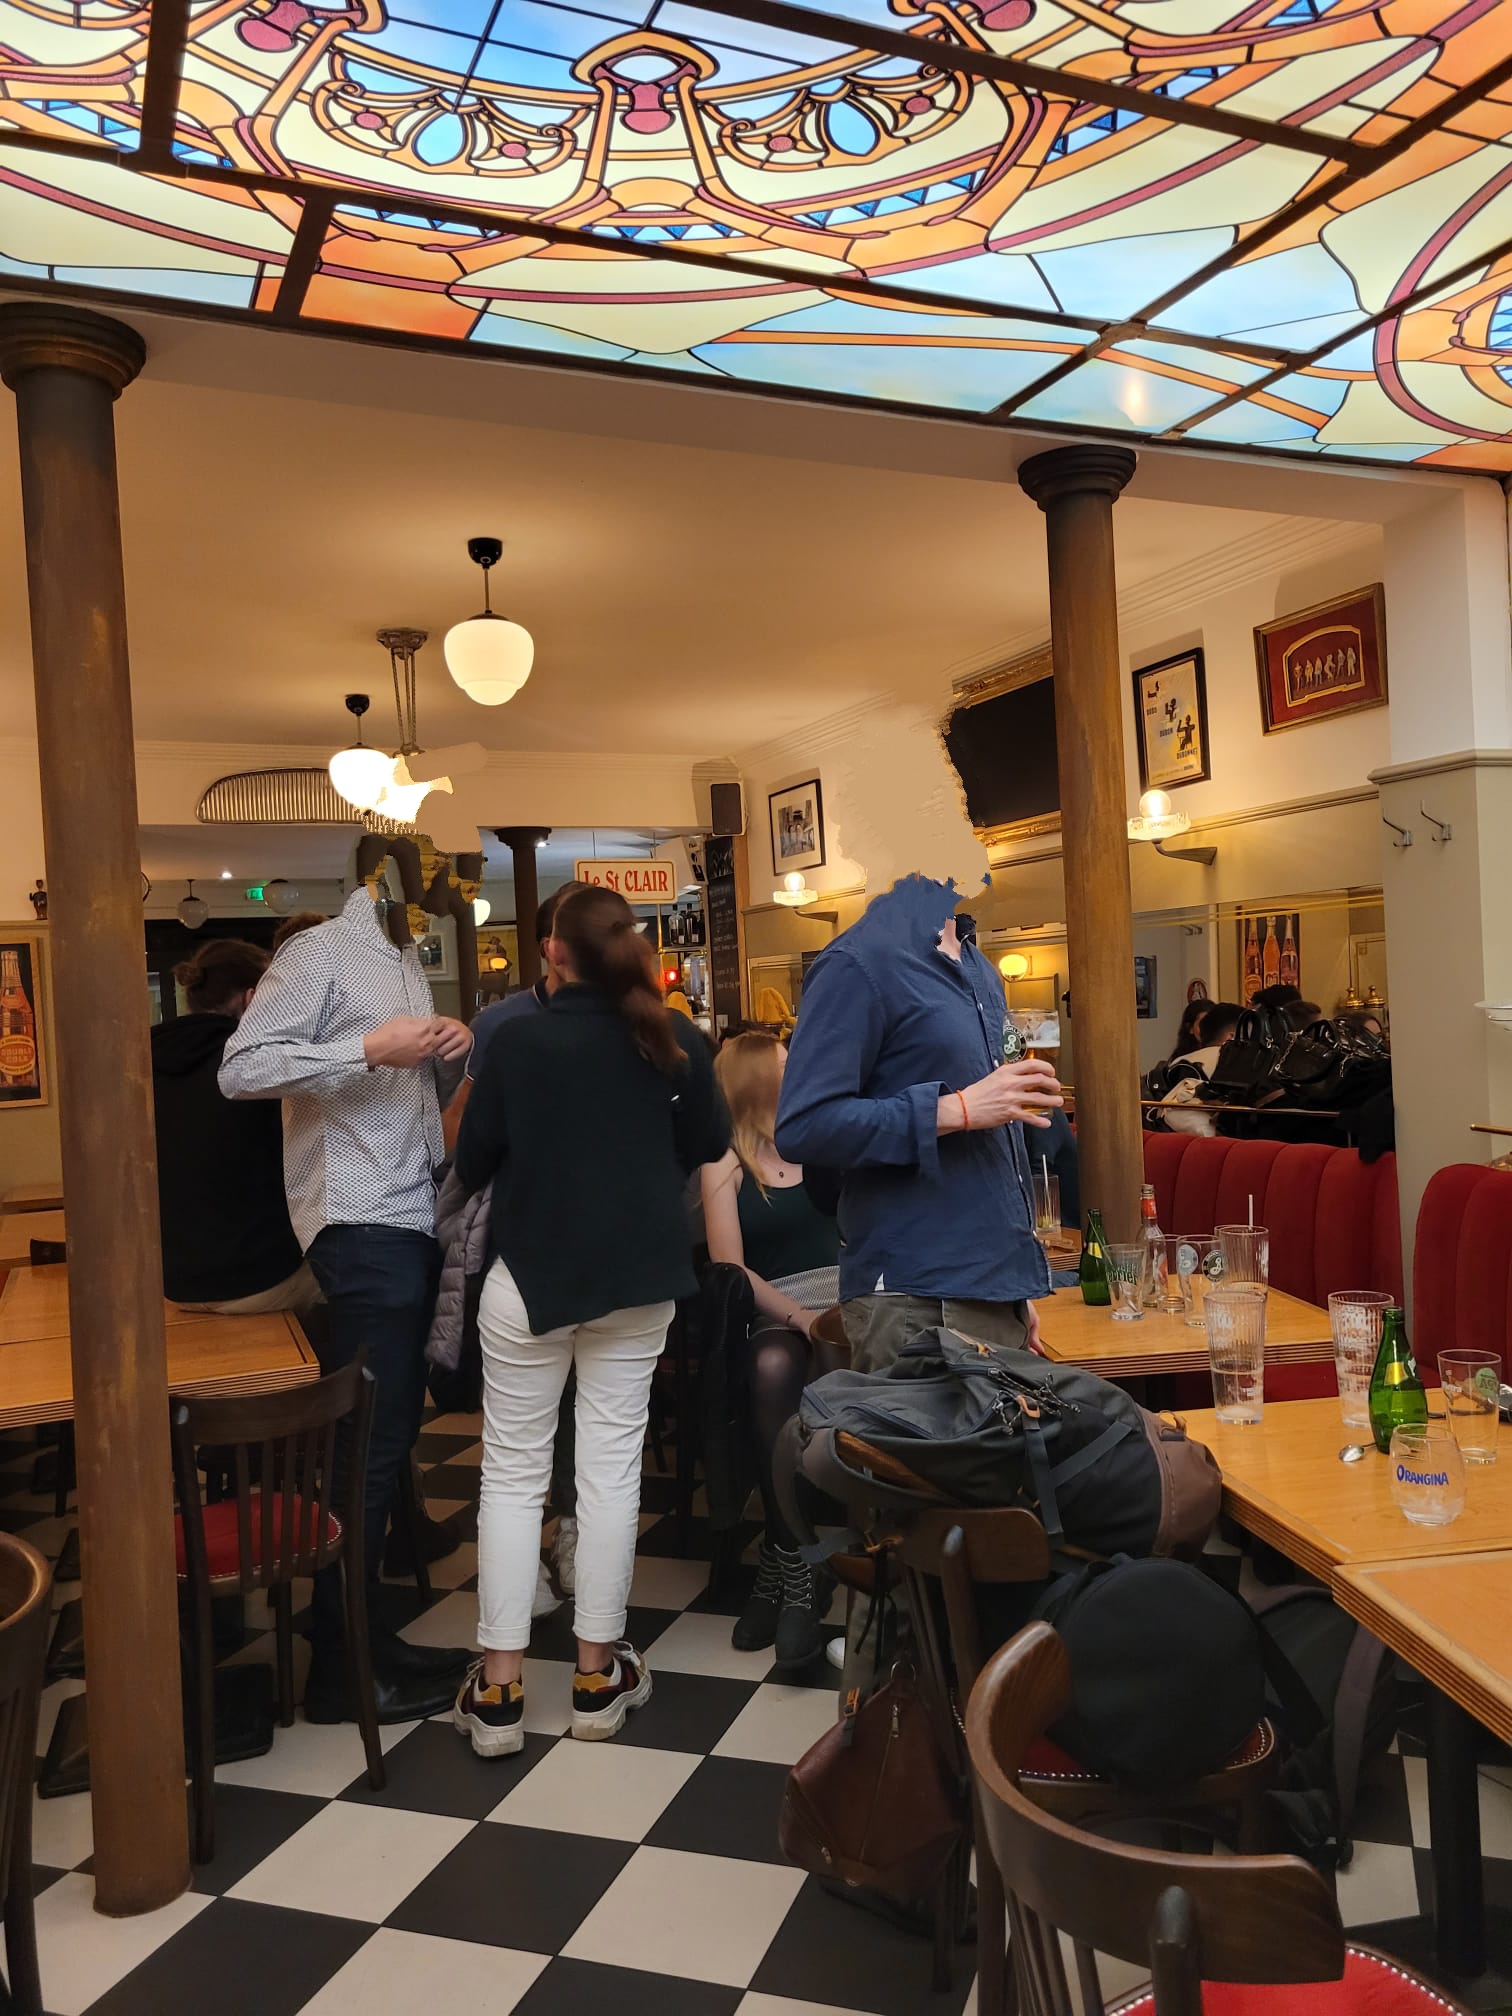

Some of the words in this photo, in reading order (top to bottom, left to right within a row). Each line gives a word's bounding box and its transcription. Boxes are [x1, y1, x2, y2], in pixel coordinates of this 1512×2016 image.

[584, 870, 600, 887] Le
[605, 870, 619, 892] St
[624, 870, 669, 893] CLAIR
[1396, 1464, 1449, 1486] ORANGINA
